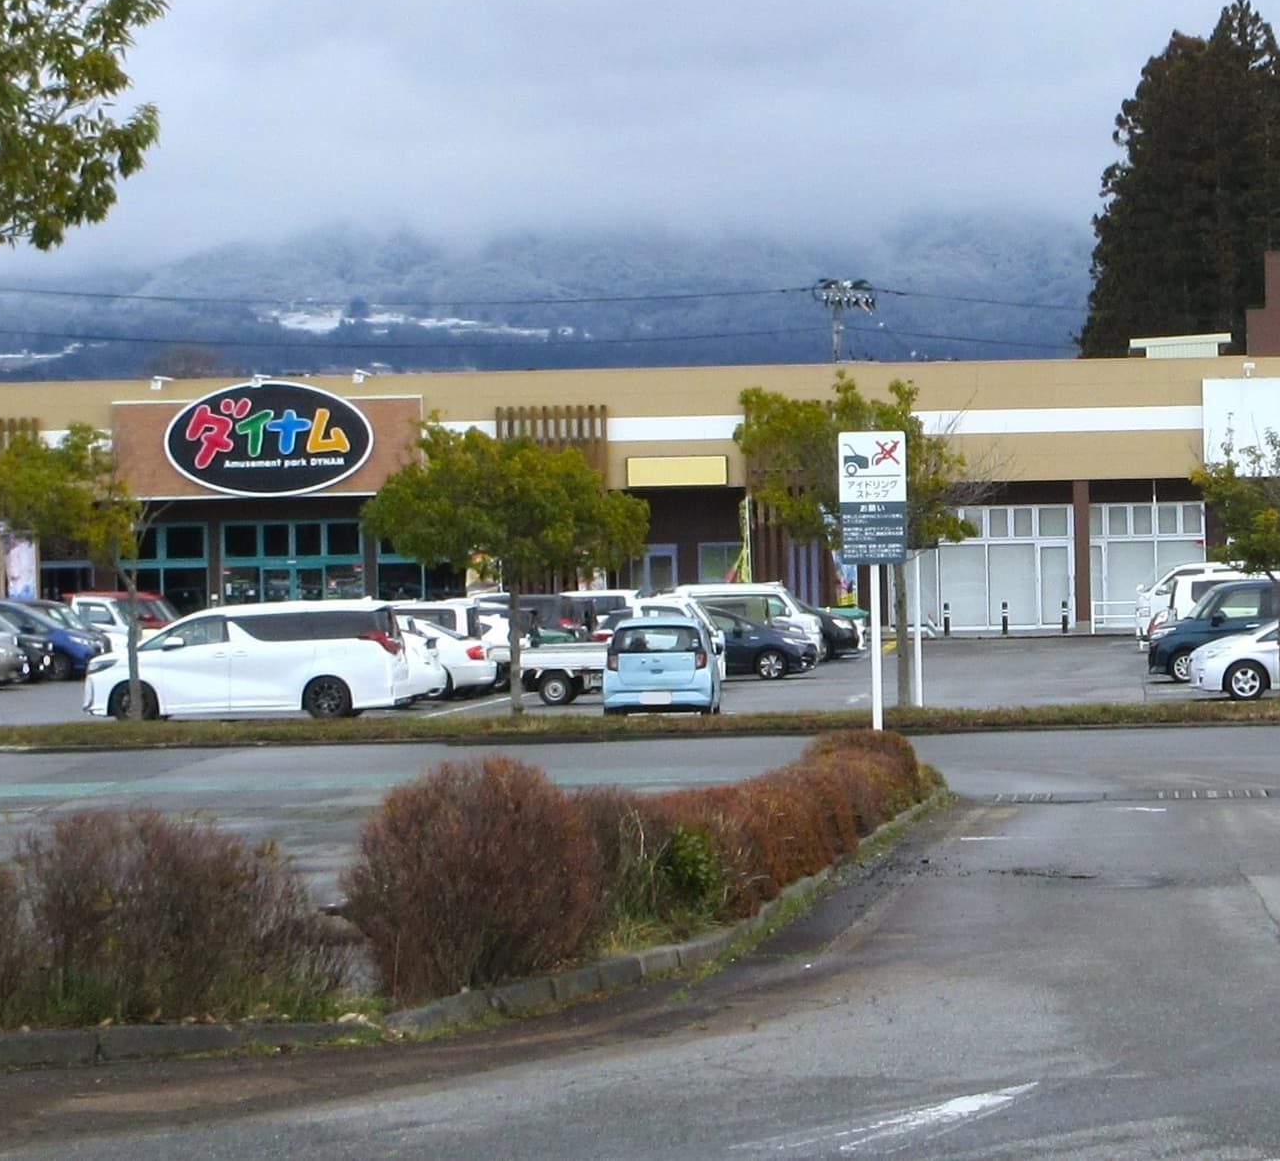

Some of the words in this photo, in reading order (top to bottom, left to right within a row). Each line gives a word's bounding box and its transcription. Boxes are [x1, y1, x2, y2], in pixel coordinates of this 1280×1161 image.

[185, 397, 351, 470] ダイナム
[223, 458, 282, 469] Amusement
[284, 458, 308, 469] park
[310, 457, 345, 467] DYNAM
[847, 480, 898, 490] アイドリング
[856, 489, 889, 499] ストップ
